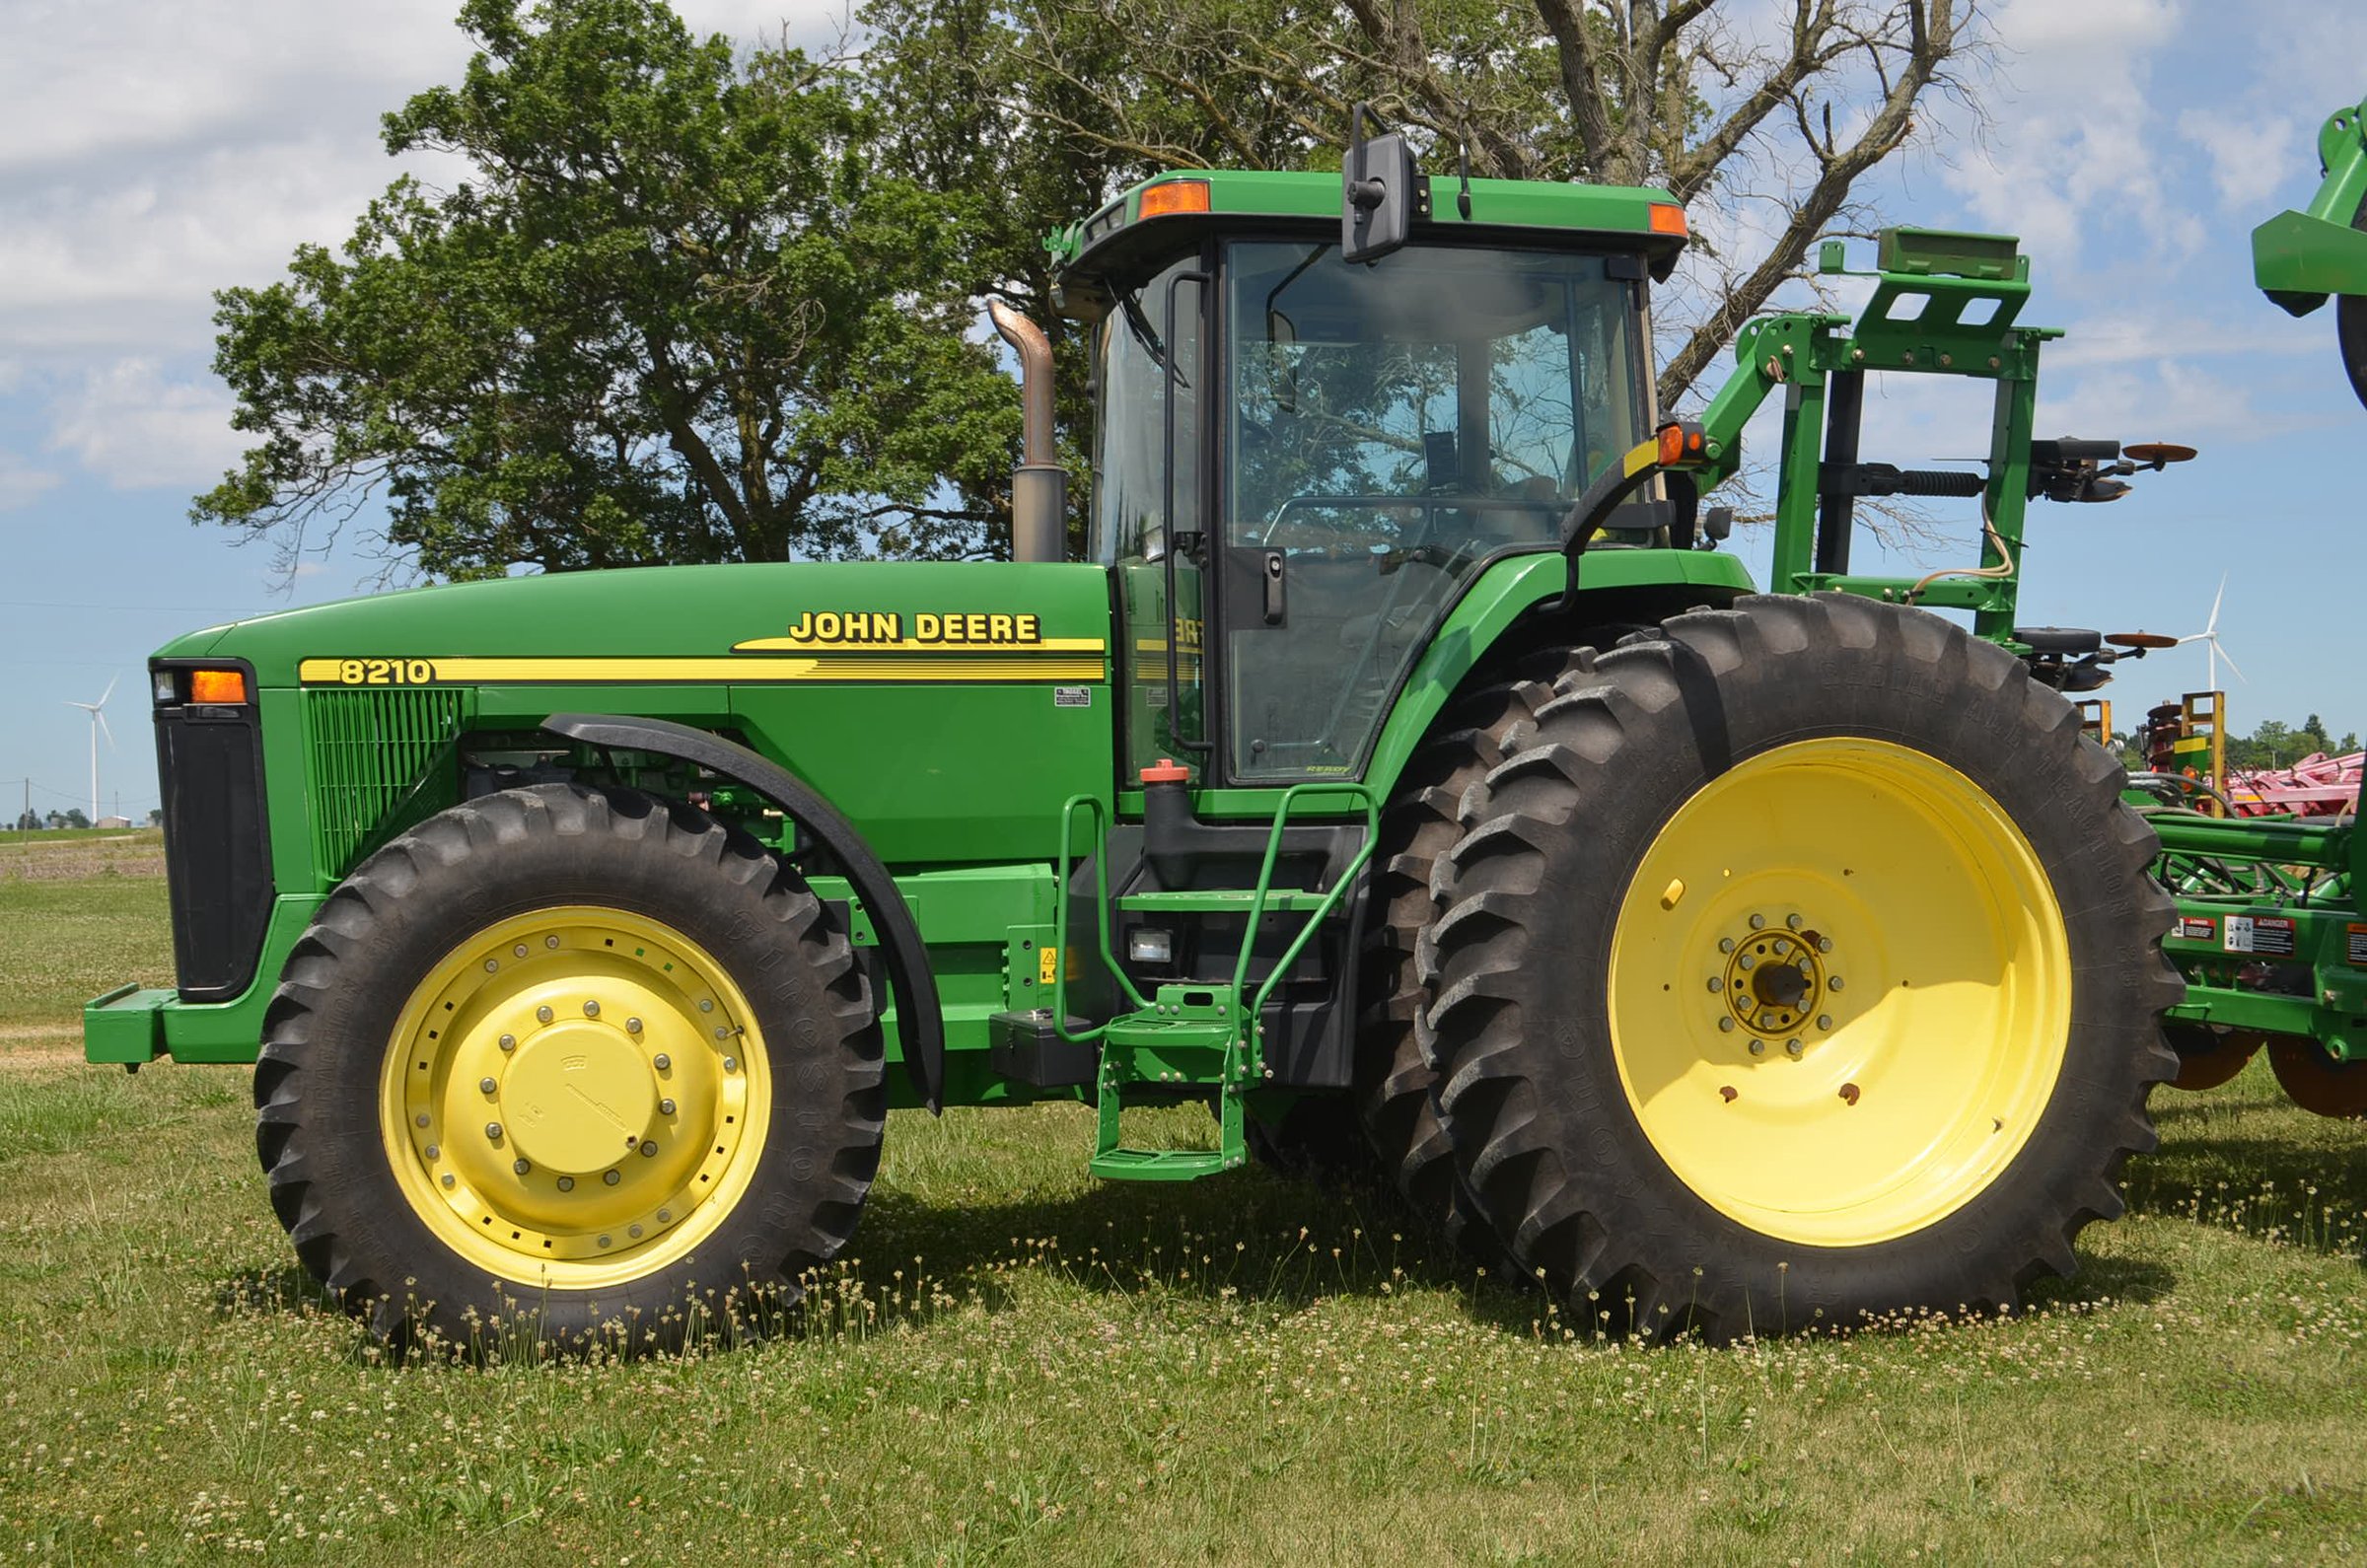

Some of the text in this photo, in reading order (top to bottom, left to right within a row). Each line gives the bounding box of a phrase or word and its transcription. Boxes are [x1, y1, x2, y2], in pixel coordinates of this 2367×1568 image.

[789, 611, 1041, 644] JOHN DEERE
[340, 659, 435, 684] 8210
